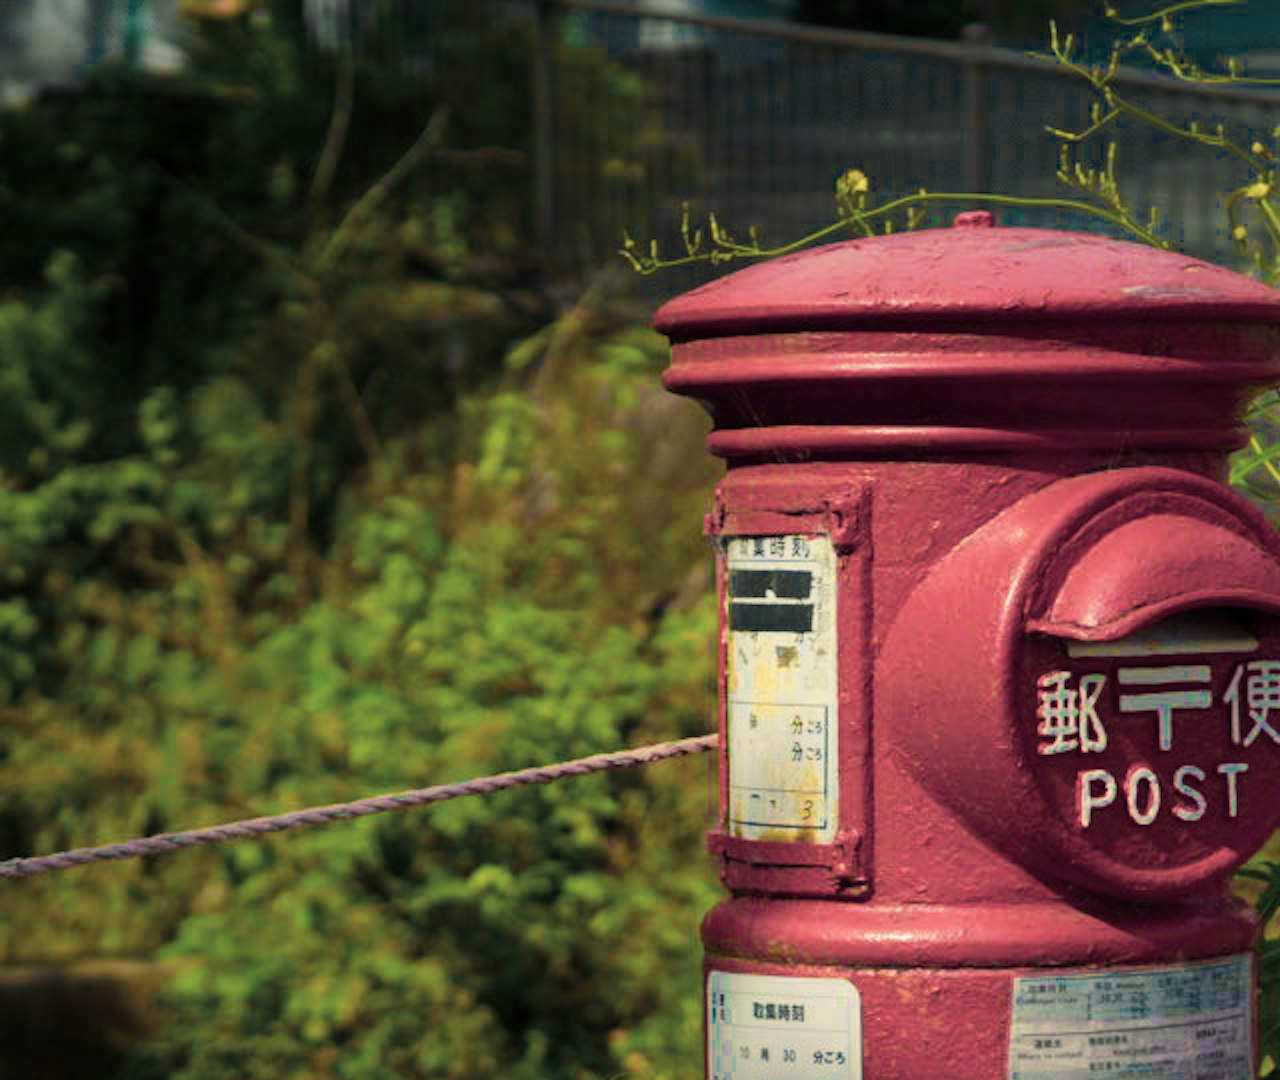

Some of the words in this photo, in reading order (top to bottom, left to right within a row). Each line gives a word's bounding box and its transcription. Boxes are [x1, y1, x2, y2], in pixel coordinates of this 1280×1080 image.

[1077, 763, 1249, 828] POST
[753, 1002, 805, 1022] 取集時刻
[783, 1049, 797, 1063] 30
[813, 1050, 847, 1065] 分ごろ
